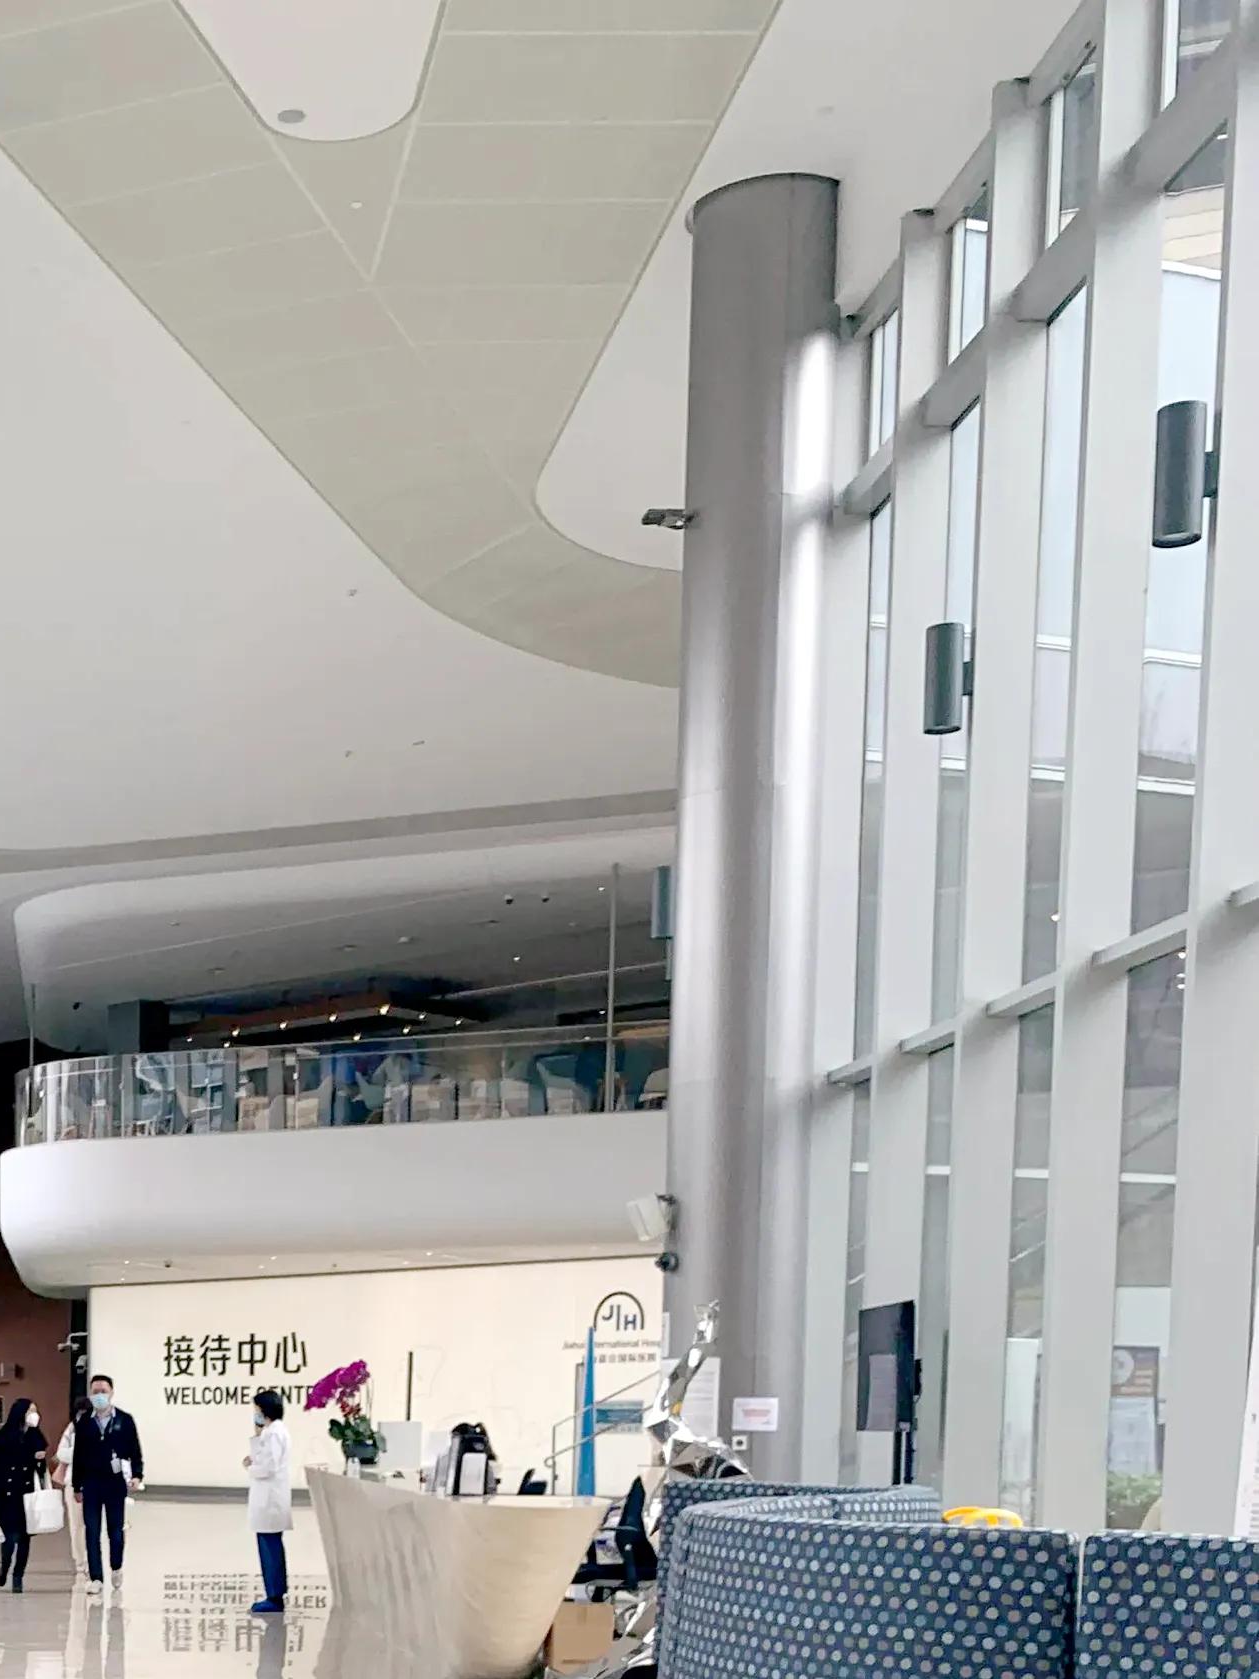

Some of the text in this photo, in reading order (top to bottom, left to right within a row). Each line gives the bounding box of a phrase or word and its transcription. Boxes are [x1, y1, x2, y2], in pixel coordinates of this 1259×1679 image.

[163, 1332, 307, 1377] 接待中心
[164, 1386, 250, 1405] WELCOME
